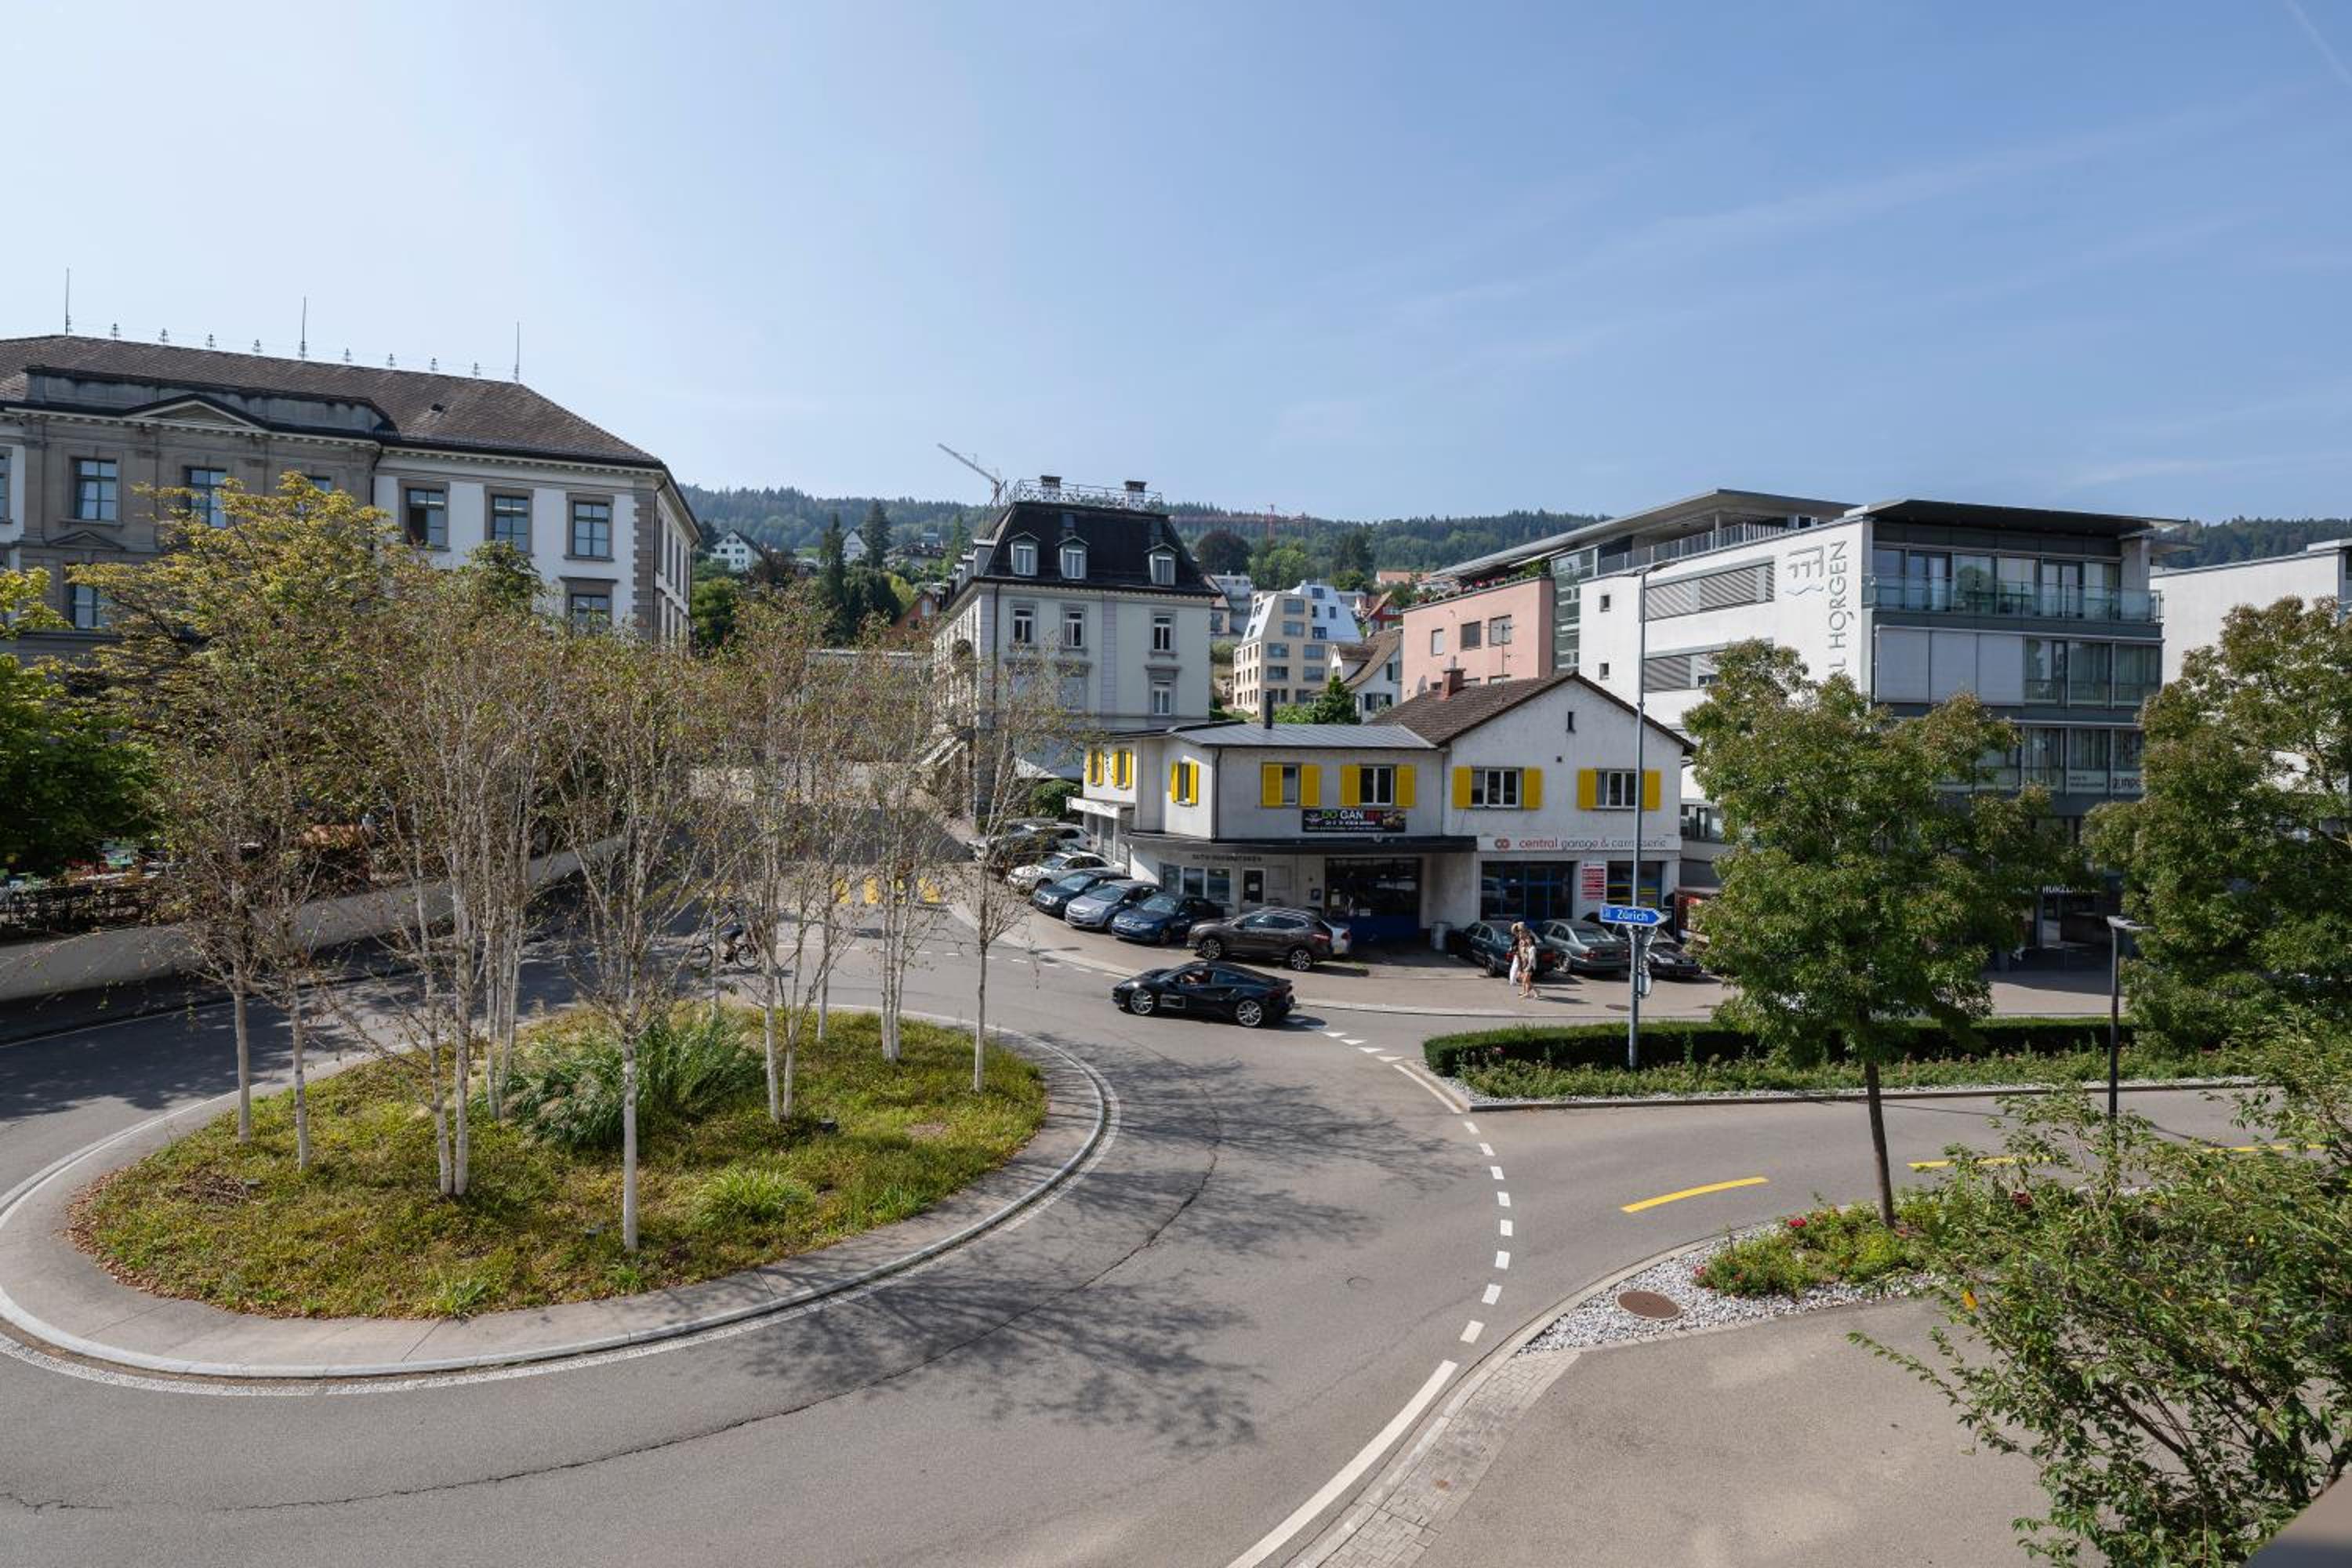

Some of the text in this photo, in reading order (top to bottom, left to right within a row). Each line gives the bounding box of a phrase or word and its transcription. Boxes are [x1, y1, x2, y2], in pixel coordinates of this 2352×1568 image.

[1829, 540, 1847, 649] HORGEN
[1519, 836, 1558, 848] central
[1561, 840, 1598, 851] garage
[1617, 909, 1649, 922] Zürich
